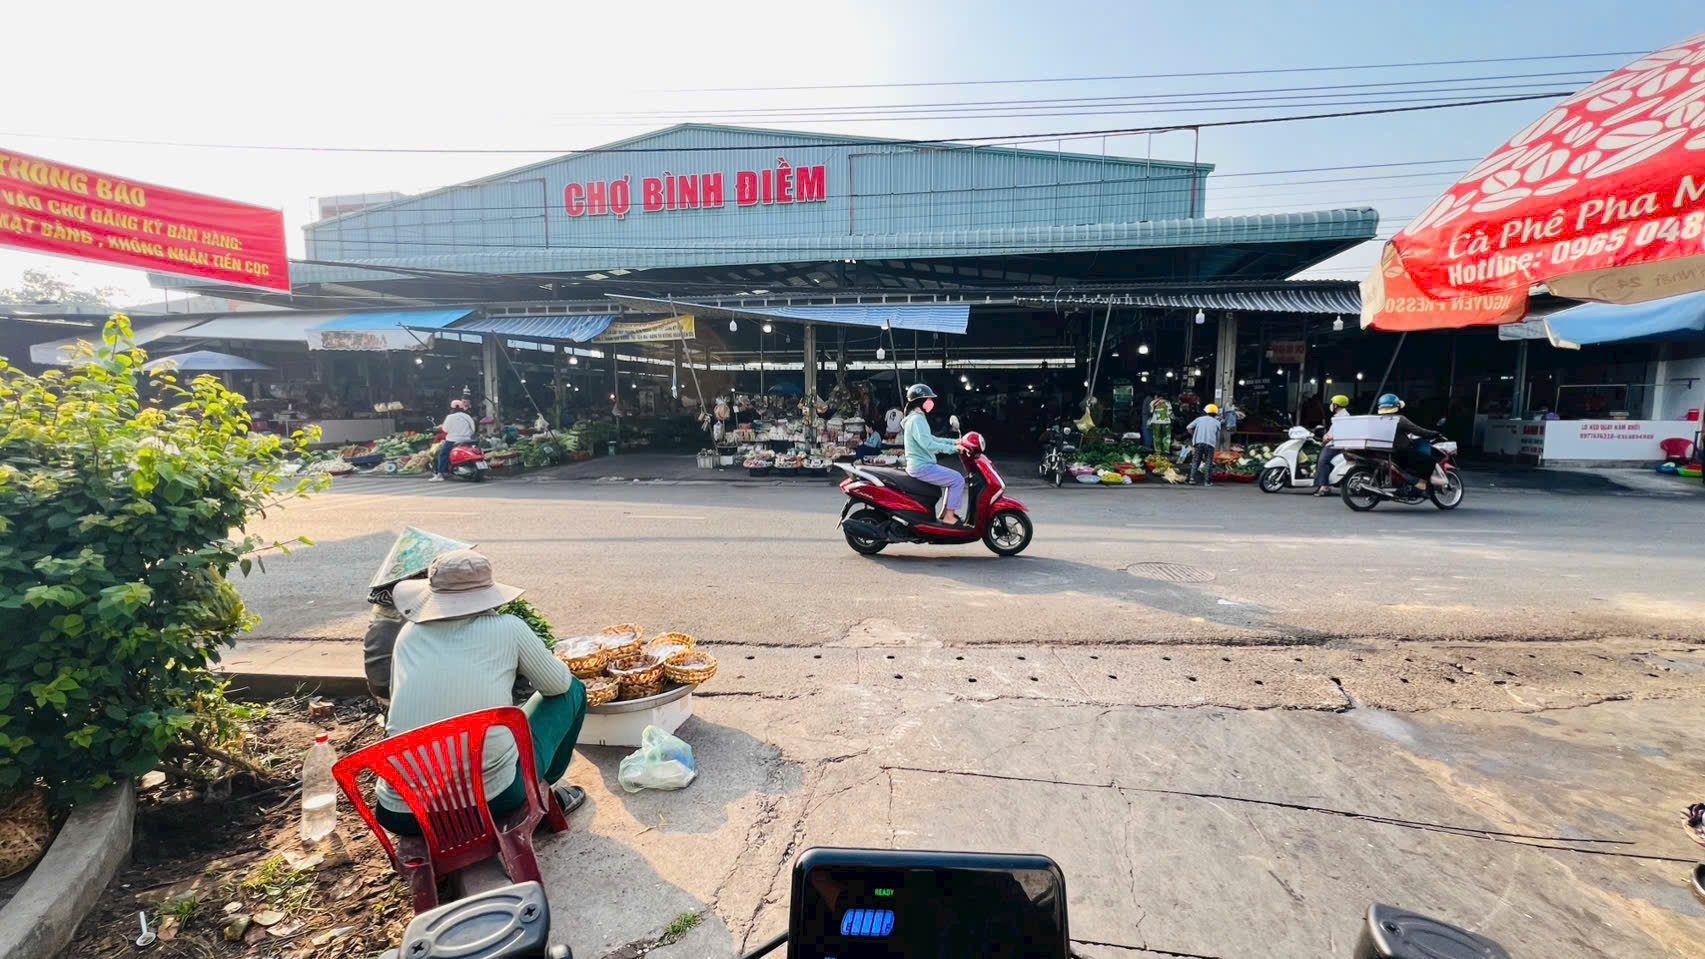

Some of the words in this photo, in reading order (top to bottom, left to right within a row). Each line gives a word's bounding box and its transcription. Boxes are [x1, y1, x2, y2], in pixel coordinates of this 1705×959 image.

[563, 176, 632, 220] CHỢ
[641, 171, 725, 212] BÌNH
[1447, 230, 1490, 260] Cà
[1499, 210, 1564, 249] Phê
[1575, 191, 1660, 230] Pha
[107, 234, 164, 258] KHÔNG
[245, 261, 270, 278] CỌC
[1447, 250, 1544, 287] Hotline:
[1551, 228, 1628, 265] 0965
[874, 888, 895, 896] READY
